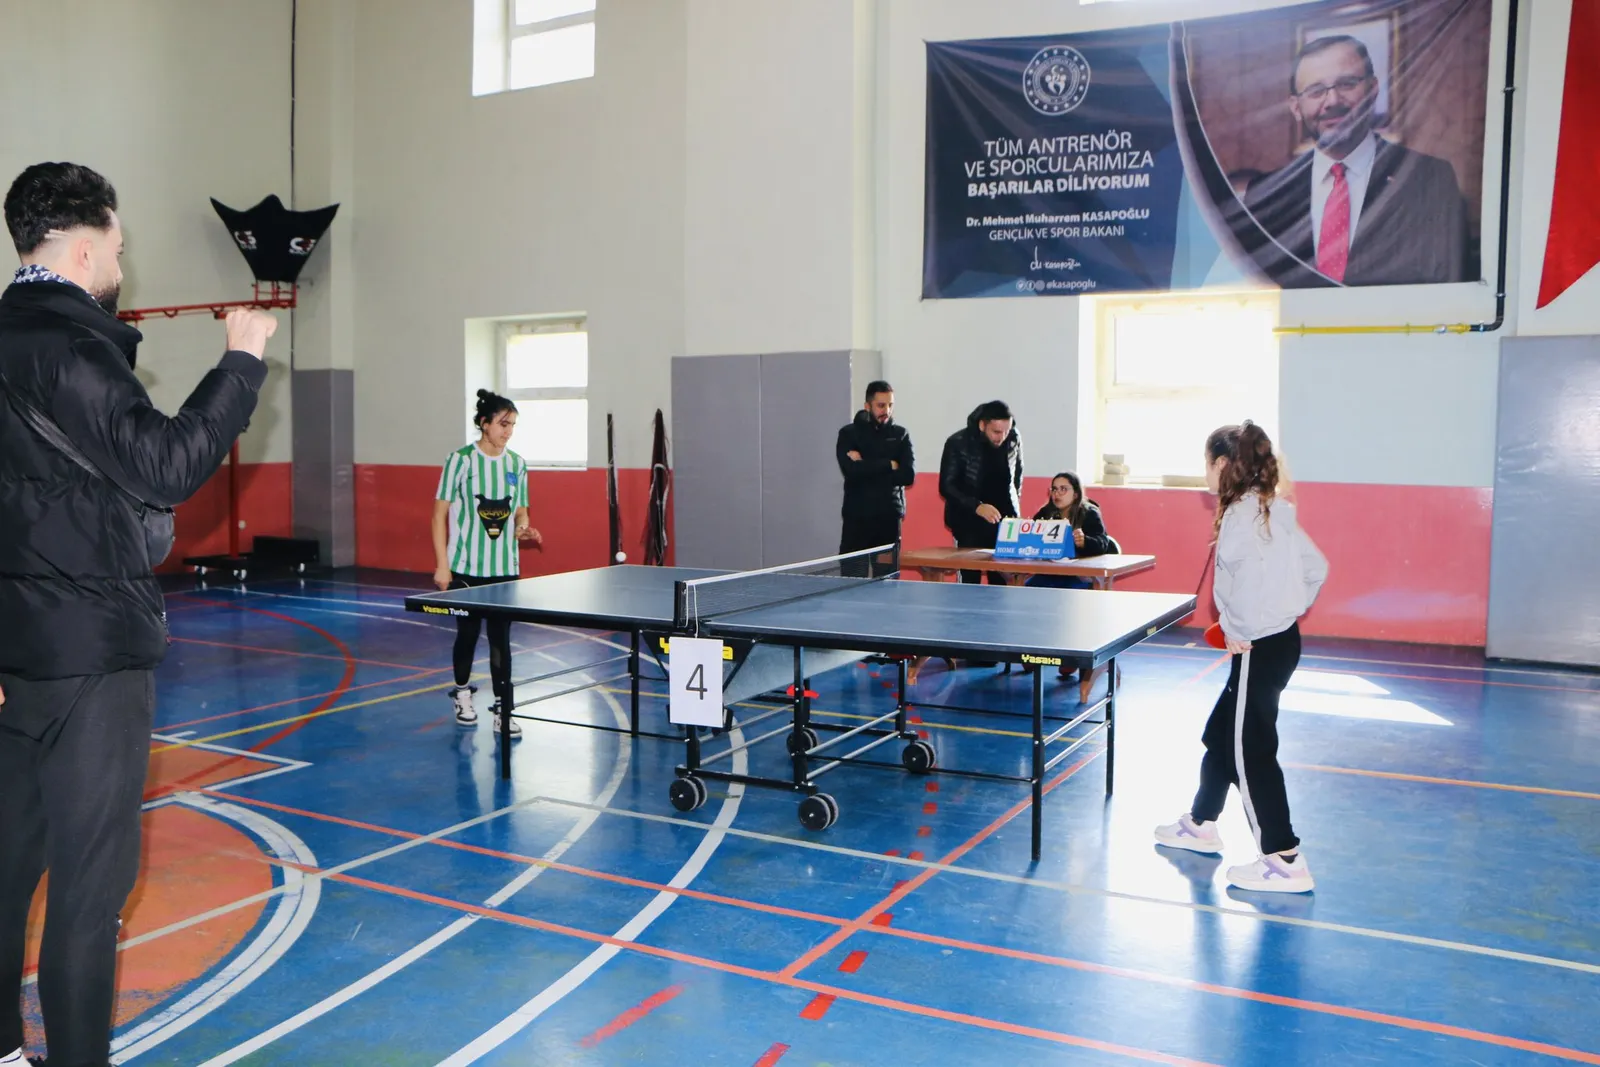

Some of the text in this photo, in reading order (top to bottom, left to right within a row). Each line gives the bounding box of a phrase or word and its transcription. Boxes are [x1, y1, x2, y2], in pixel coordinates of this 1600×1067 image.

[984, 129, 1132, 158] TÜM ANTRENÖR
[964, 151, 1154, 178] VE SPORCULARIMIZA
[967, 173, 1150, 199] BAŞARILAR DİLİYORUM
[966, 207, 1150, 227] Dr. Mehmet Muharrem KASAPOĞLU
[989, 225, 1125, 243] GENÇLİK VE SPOR BAKANI
[1047, 524, 1060, 540] 4
[449, 608, 469, 616] Turbo
[1021, 653, 1062, 666] Yasaka
[685, 663, 708, 701] 4
